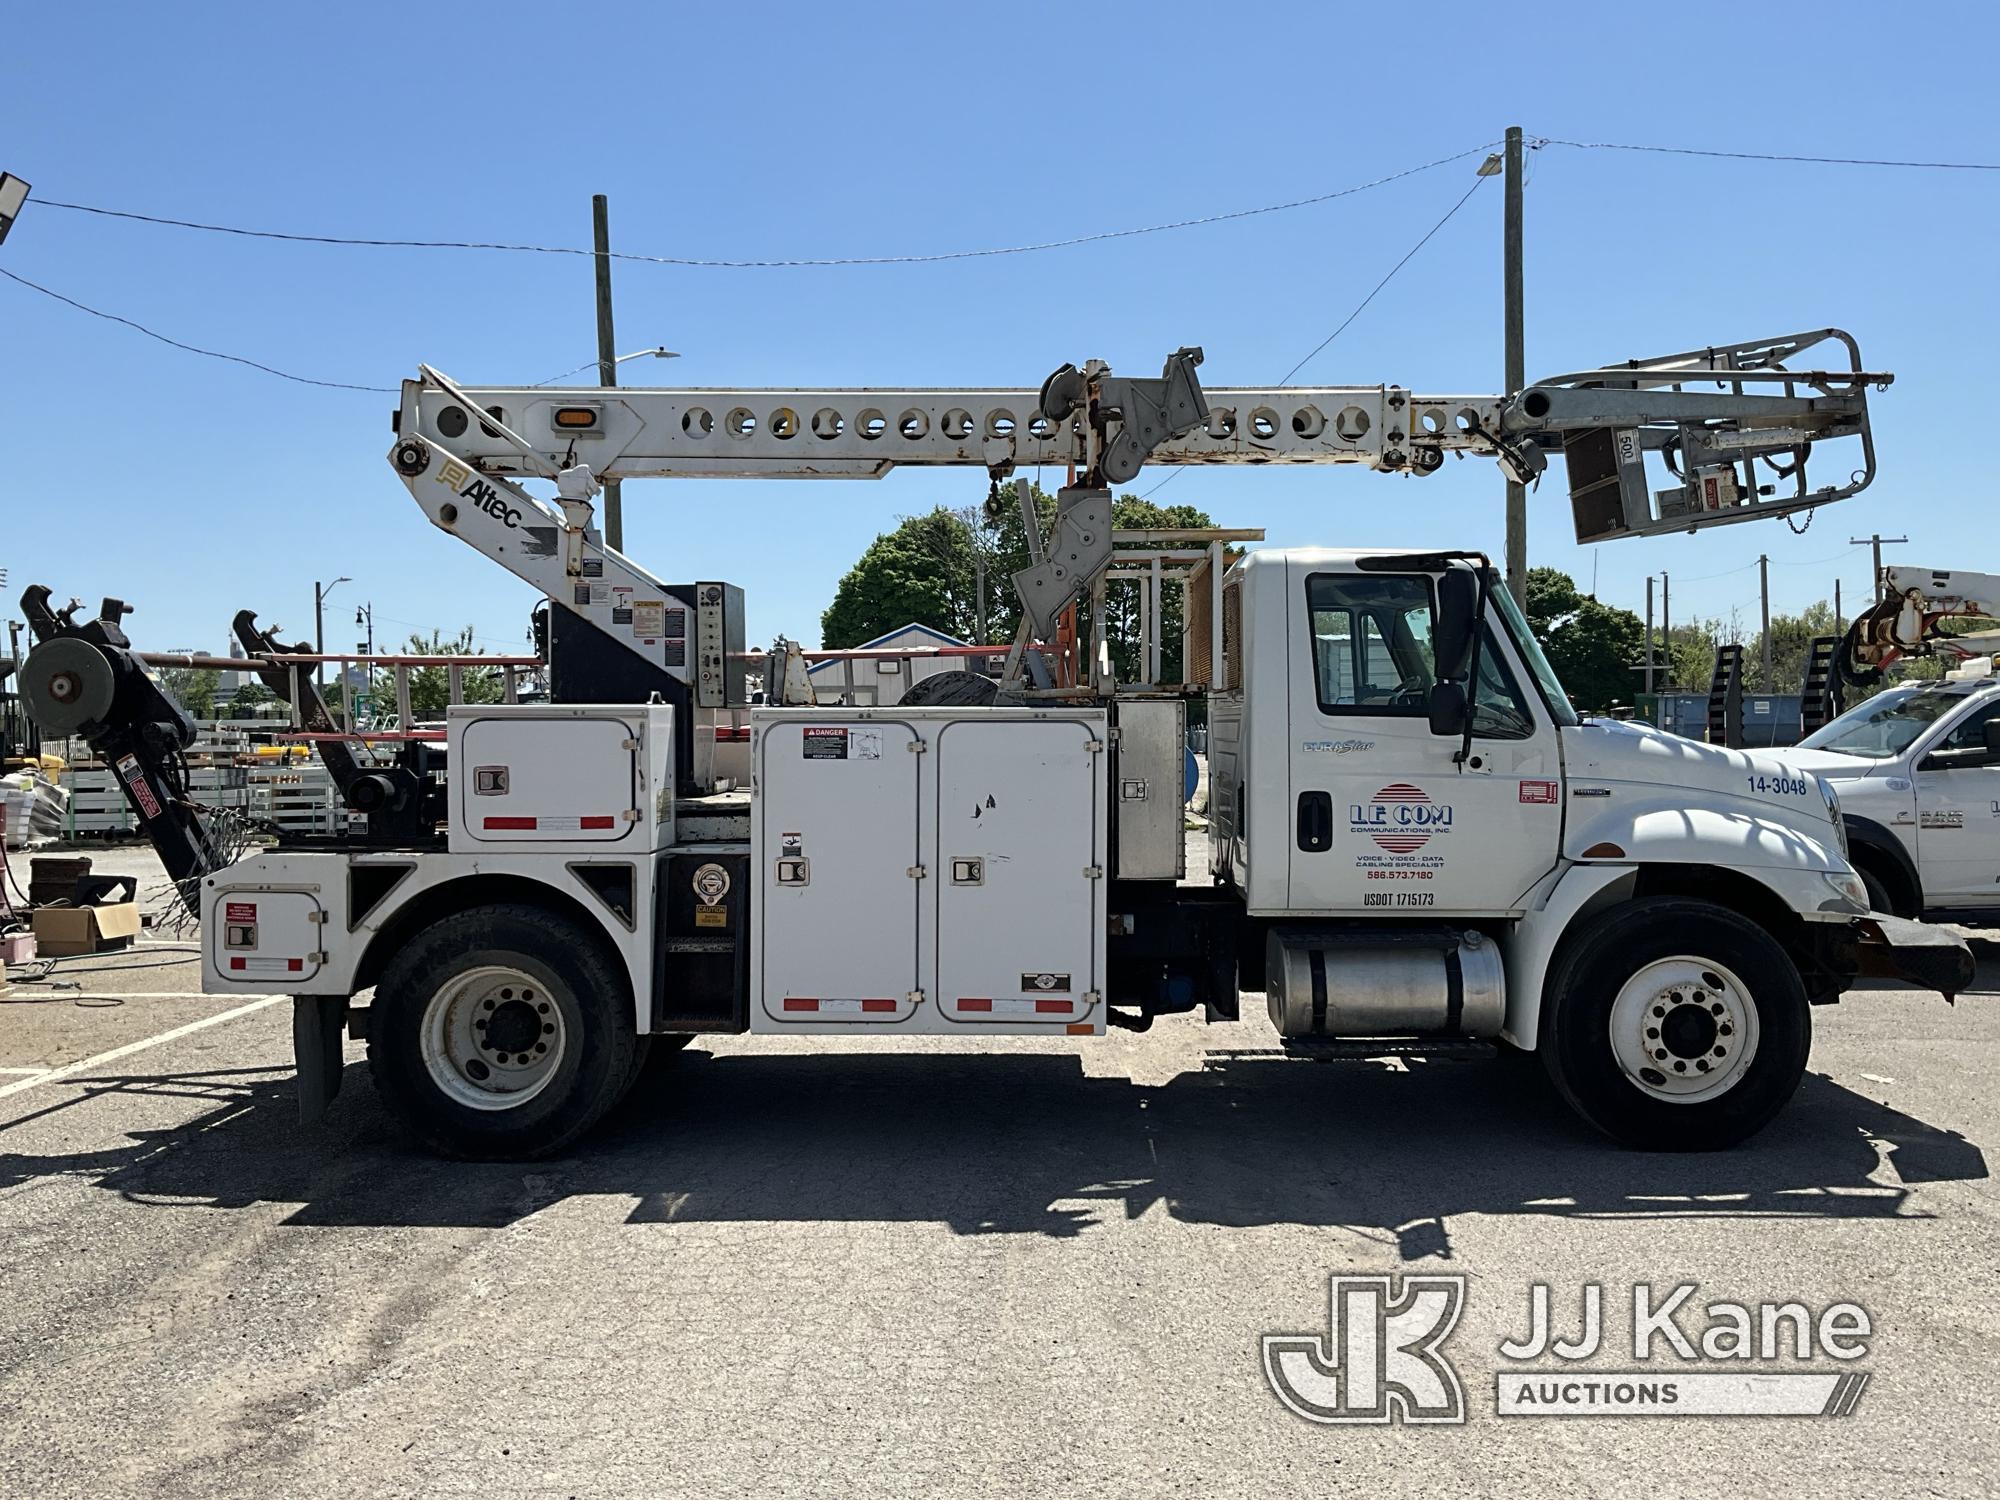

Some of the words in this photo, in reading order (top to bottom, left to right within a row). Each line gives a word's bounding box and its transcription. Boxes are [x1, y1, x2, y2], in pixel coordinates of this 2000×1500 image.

[1621, 436, 1633, 459] 500
[460, 479, 522, 529] Altec
[1747, 776, 1807, 796] 14-3048
[1350, 805, 1387, 825] LE
[1393, 805, 1453, 825] COM
[1367, 871, 1434, 880] 586.573.7180
[1363, 893, 1394, 906] USDOT
[1396, 893, 1435, 906] 1715173
